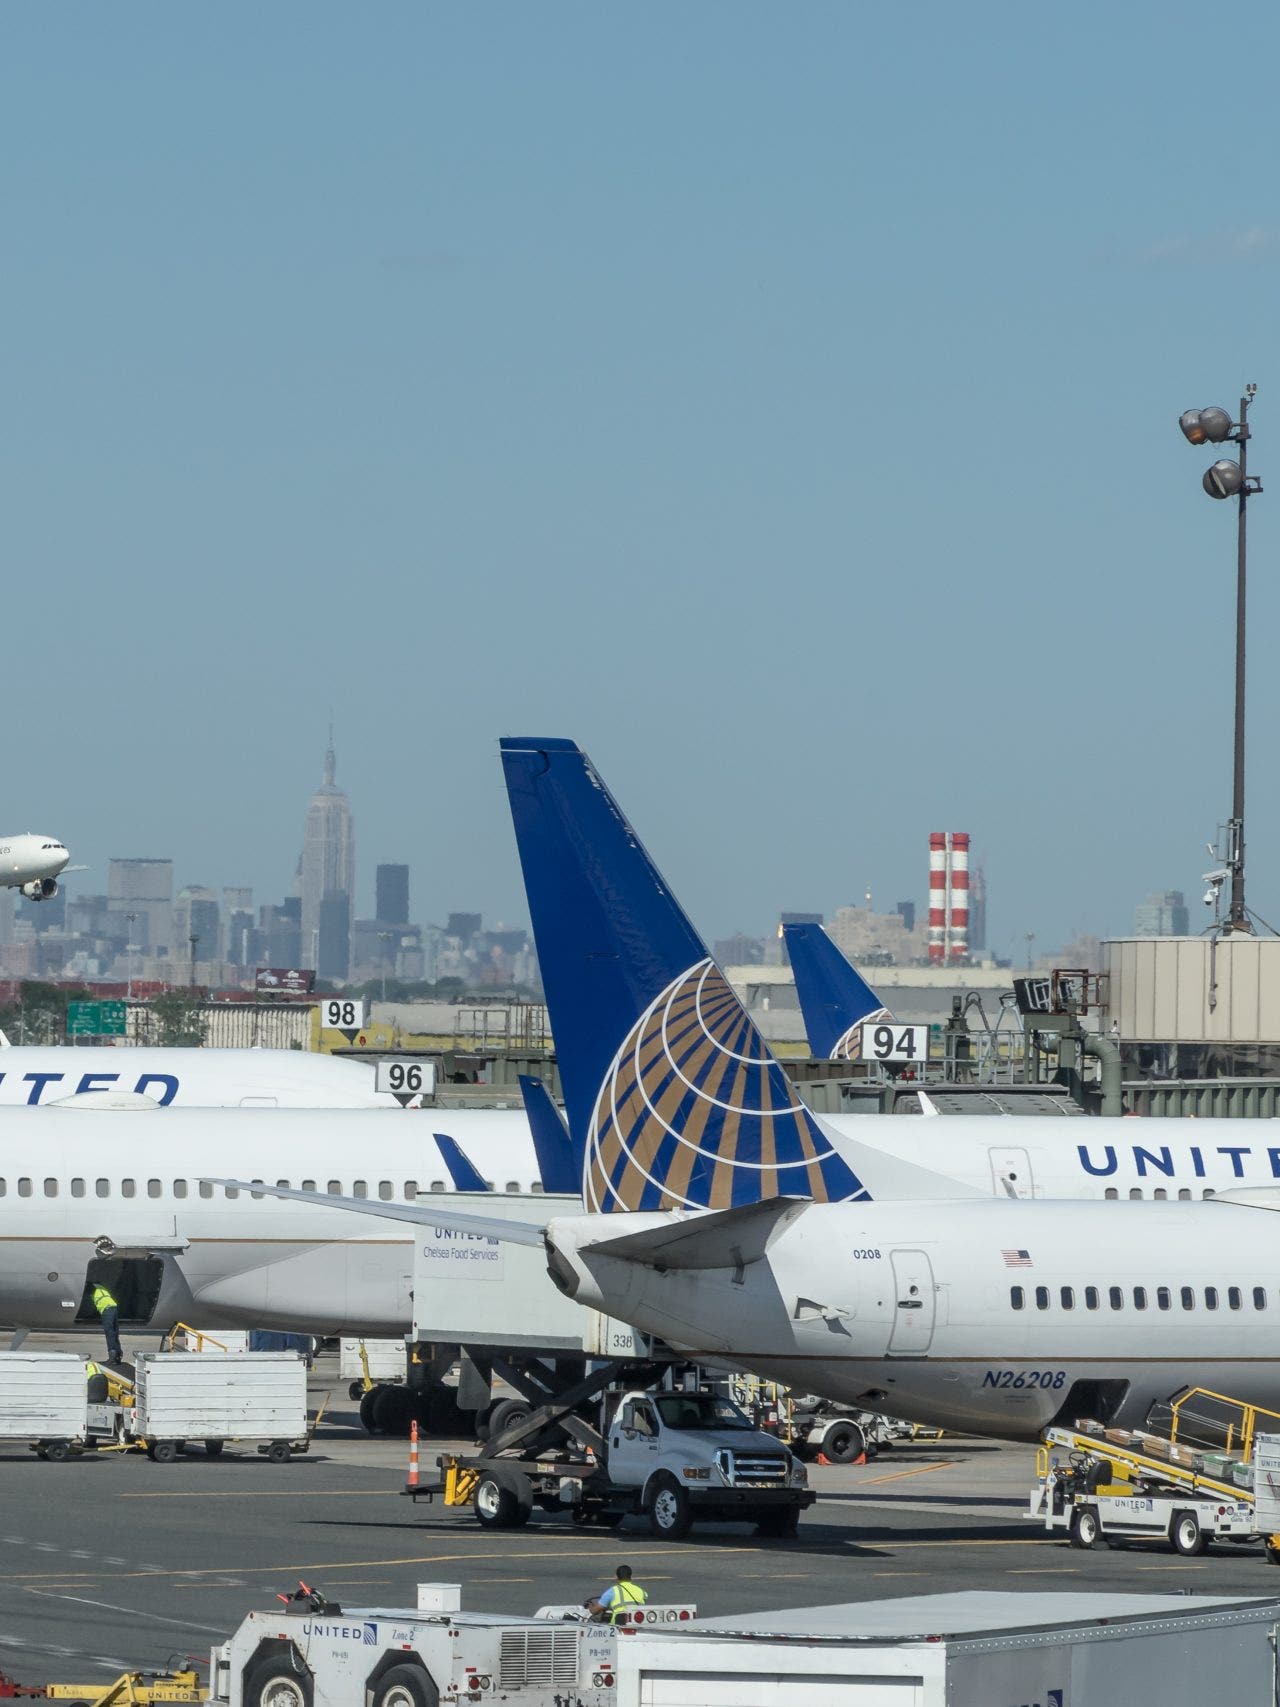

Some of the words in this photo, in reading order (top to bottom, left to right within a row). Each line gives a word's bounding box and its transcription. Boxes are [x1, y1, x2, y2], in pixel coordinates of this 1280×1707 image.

[328, 1001, 355, 1026] 98
[873, 1026, 917, 1059] 94
[389, 1064, 422, 1091] 96
[423, 1246, 449, 1259] Chelsea
[451, 1247, 469, 1260] Food
[470, 1246, 499, 1261] Services
[853, 1249, 881, 1259] 0208
[613, 1334, 633, 1349] 338
[982, 1370, 1066, 1389] N26208
[1115, 1500, 1146, 1509] UNITED
[303, 1624, 362, 1640] UNITED
[392, 1629, 408, 1640] Zone
[410, 1630, 415, 1641] 2
[587, 1627, 607, 1638] Zone
[609, 1627, 615, 1638] 2
[148, 1691, 189, 1700] UNITED
